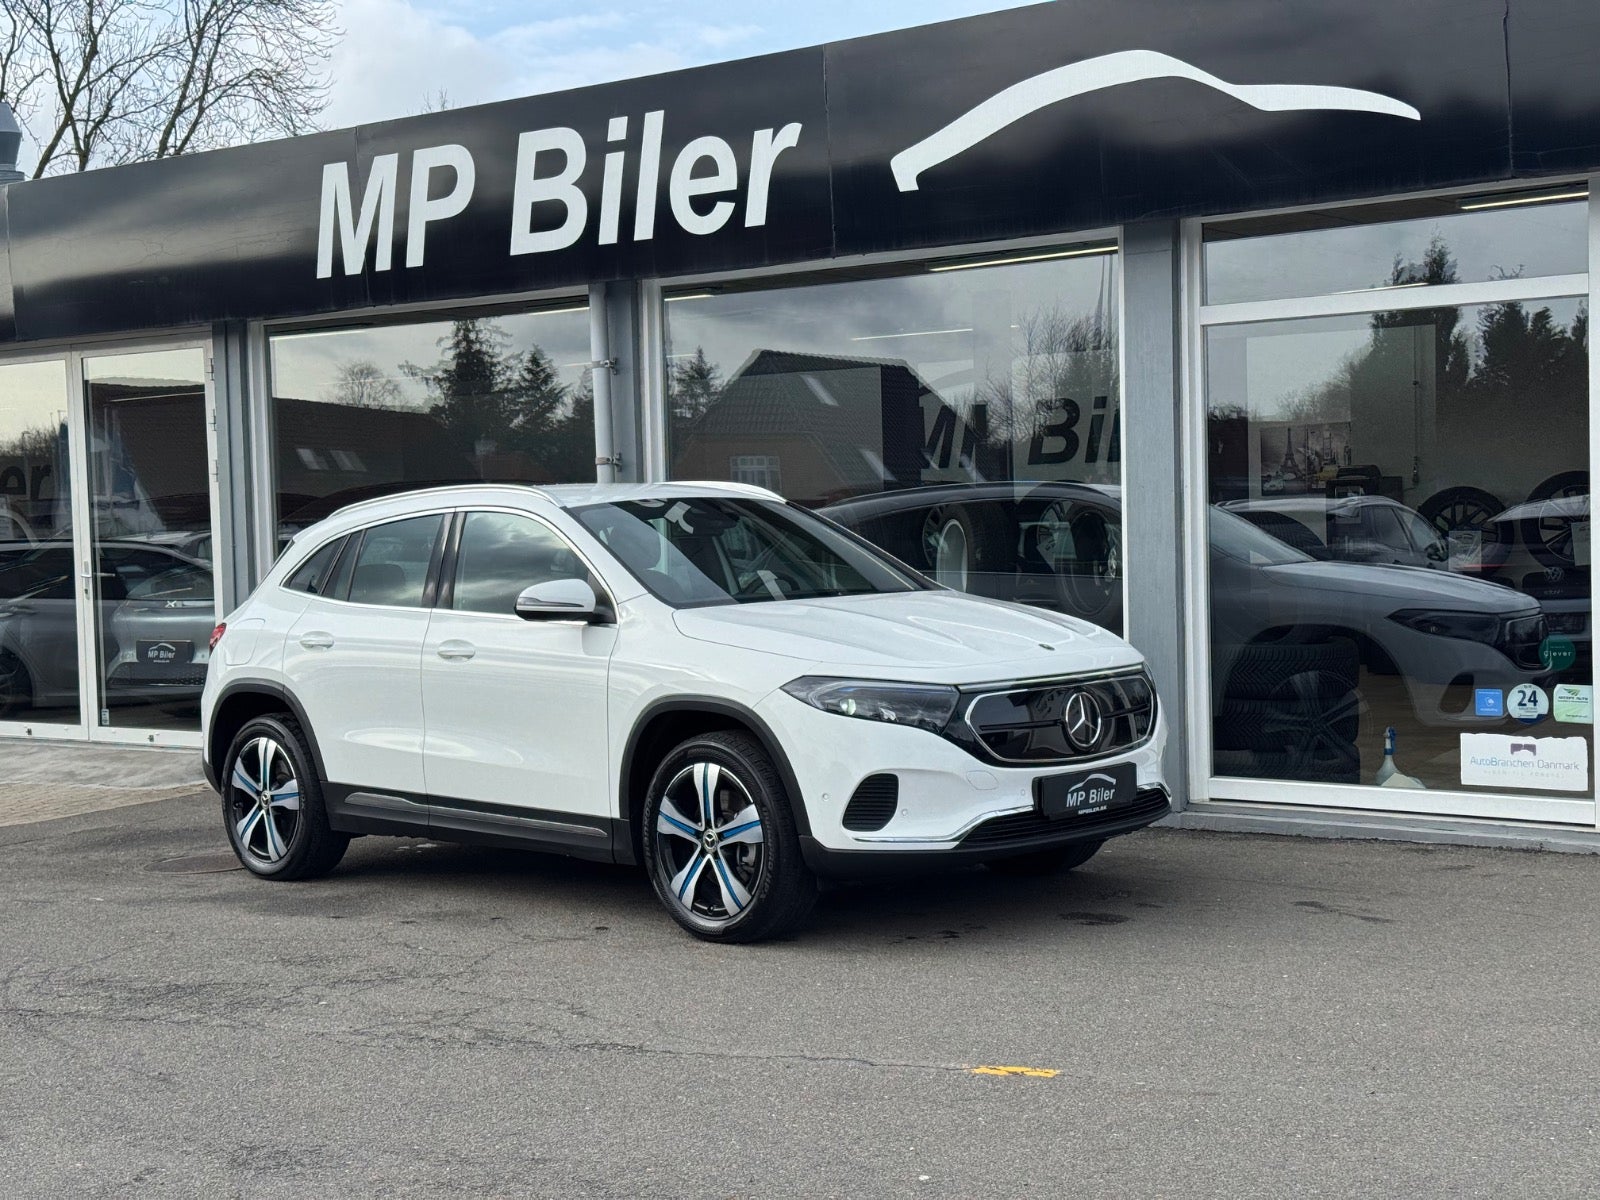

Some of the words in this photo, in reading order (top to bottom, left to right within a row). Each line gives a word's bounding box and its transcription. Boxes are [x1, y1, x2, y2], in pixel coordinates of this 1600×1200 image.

[316, 143, 476, 279] MP
[509, 109, 803, 256] Biler
[147, 650, 159, 659] MP
[159, 650, 176, 659] Biler
[1517, 690, 1538, 707] 24
[1470, 756, 1534, 768] AutoBranchen
[1537, 759, 1580, 770] Danmark
[1066, 791, 1086, 807] MP
[1089, 787, 1115, 804] Biler
